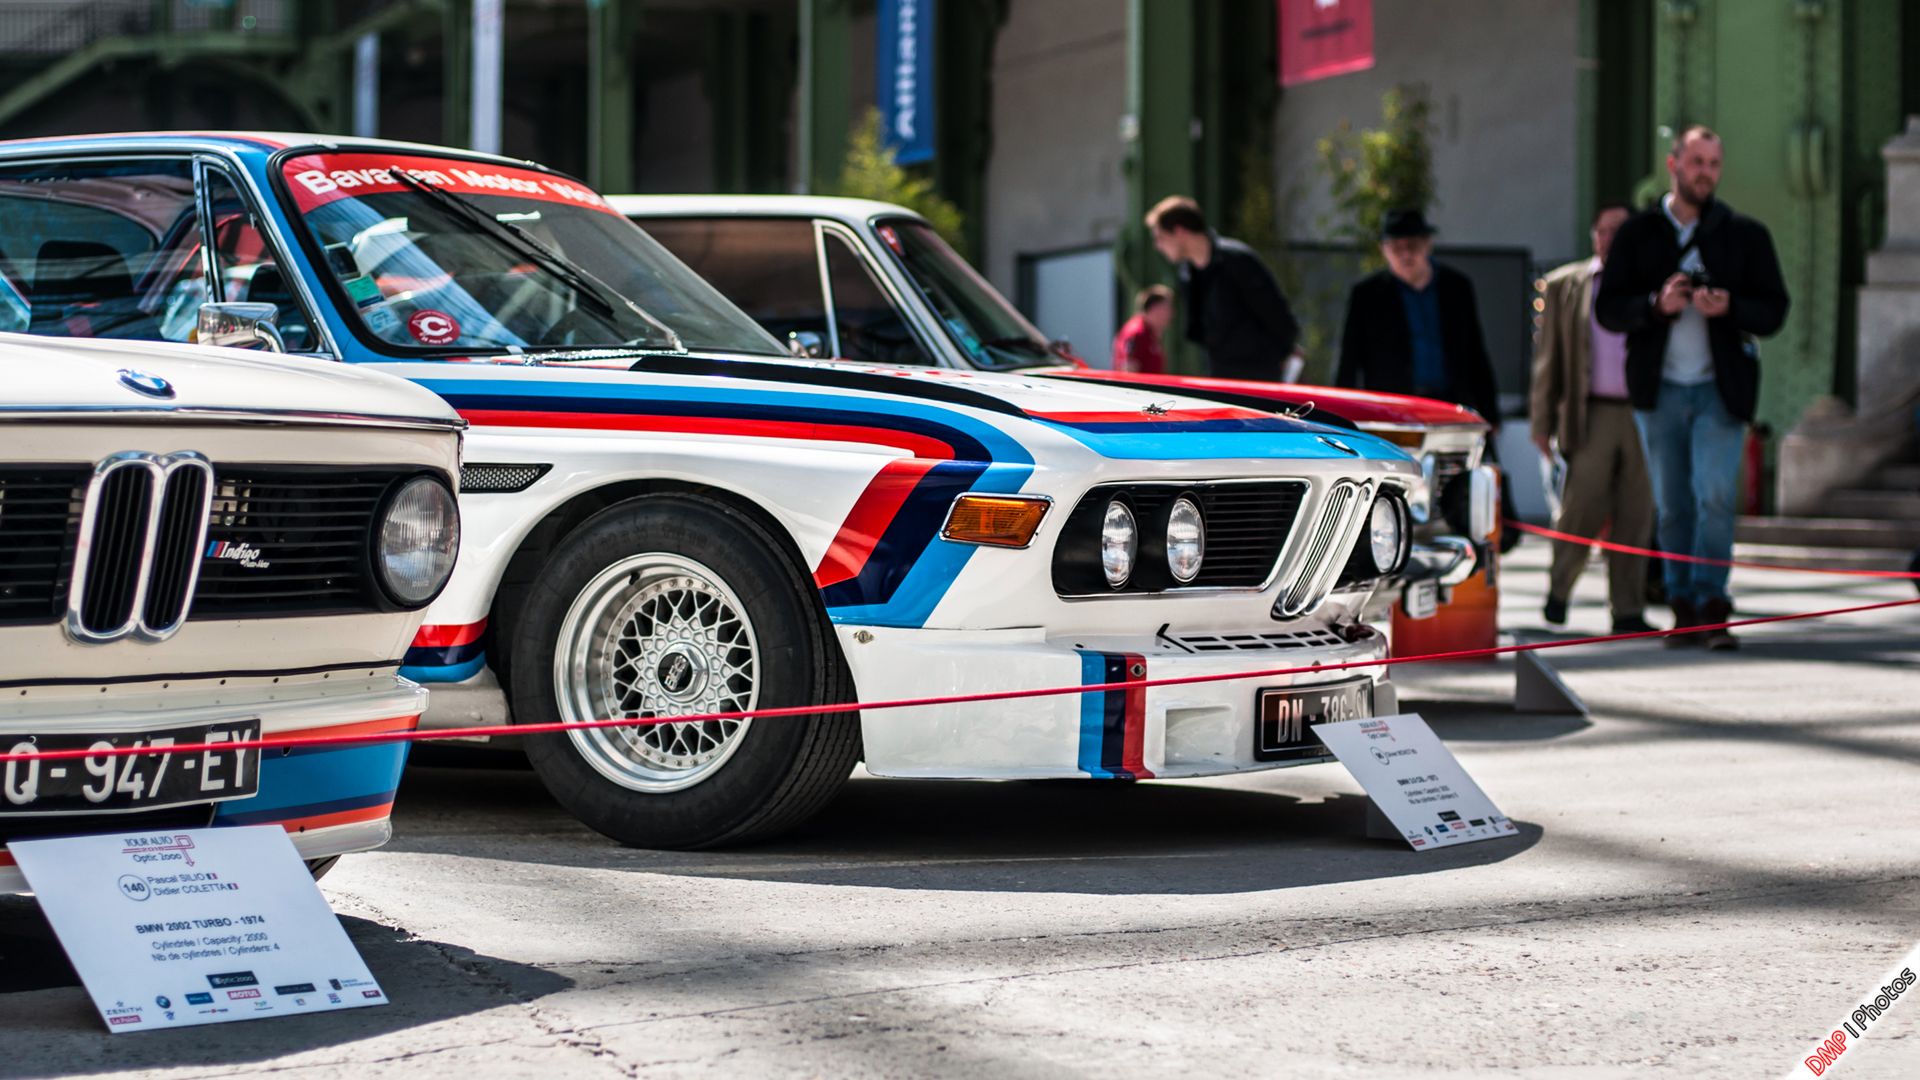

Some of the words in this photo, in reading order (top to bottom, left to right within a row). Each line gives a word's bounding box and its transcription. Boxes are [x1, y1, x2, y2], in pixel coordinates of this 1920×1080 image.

[219, 541, 261, 560] Indigo
[124, 838, 149, 847] TOUR
[150, 836, 173, 845] AUTO
[133, 853, 159, 863] Optic
[147, 875, 178, 885] Pascal
[124, 882, 146, 893] 140
[153, 886, 180, 896] Didier
[181, 882, 227, 894] COLETTA
[135, 923, 164, 934] BMW
[165, 921, 192, 931] 2002
[192, 917, 232, 929] TURBO
[240, 915, 265, 925] 1974
[229, 989, 260, 999] MOTUL
[105, 1006, 144, 1015] ZENITH
